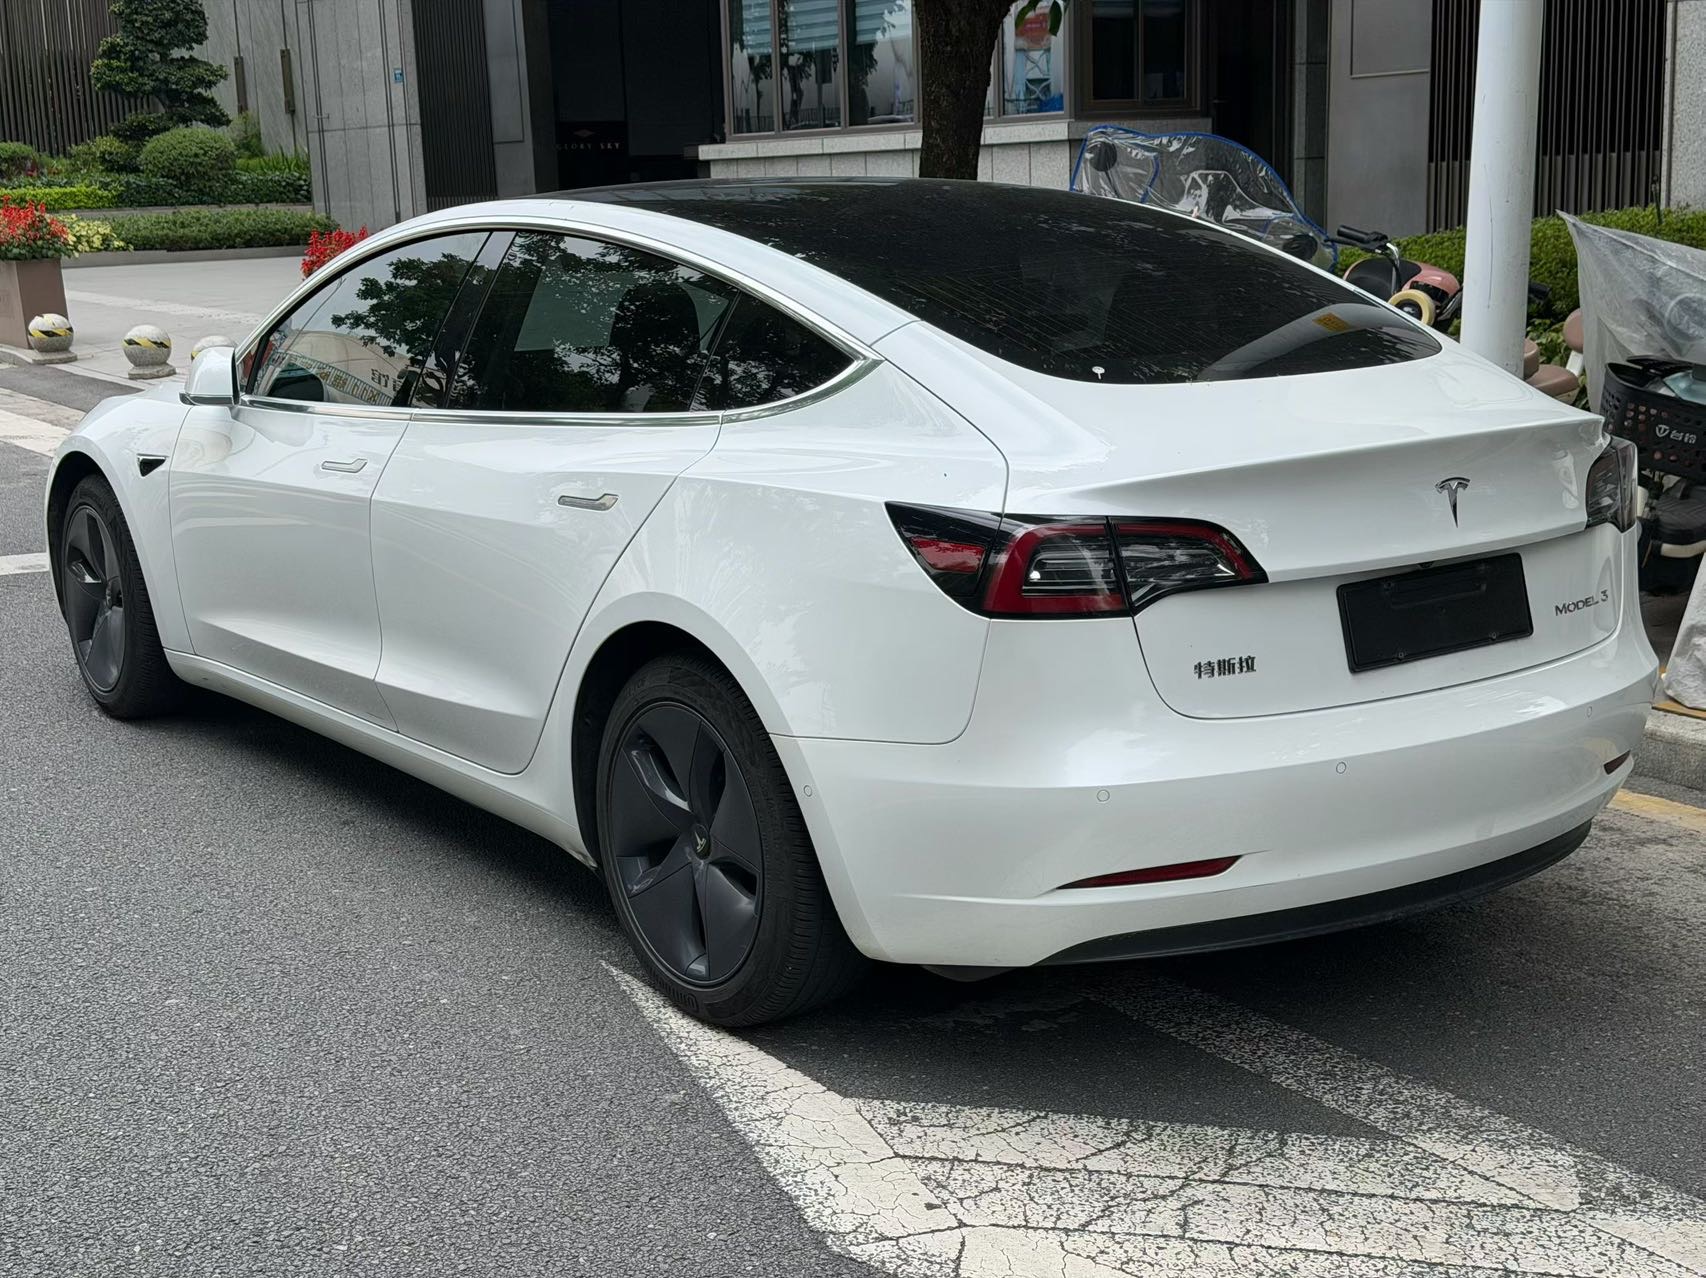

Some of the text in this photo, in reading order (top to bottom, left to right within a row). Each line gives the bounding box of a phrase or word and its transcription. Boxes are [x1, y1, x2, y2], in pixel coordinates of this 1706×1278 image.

[1555, 590, 1608, 616] MODEL 3
[1194, 655, 1256, 679] 特斯拉
